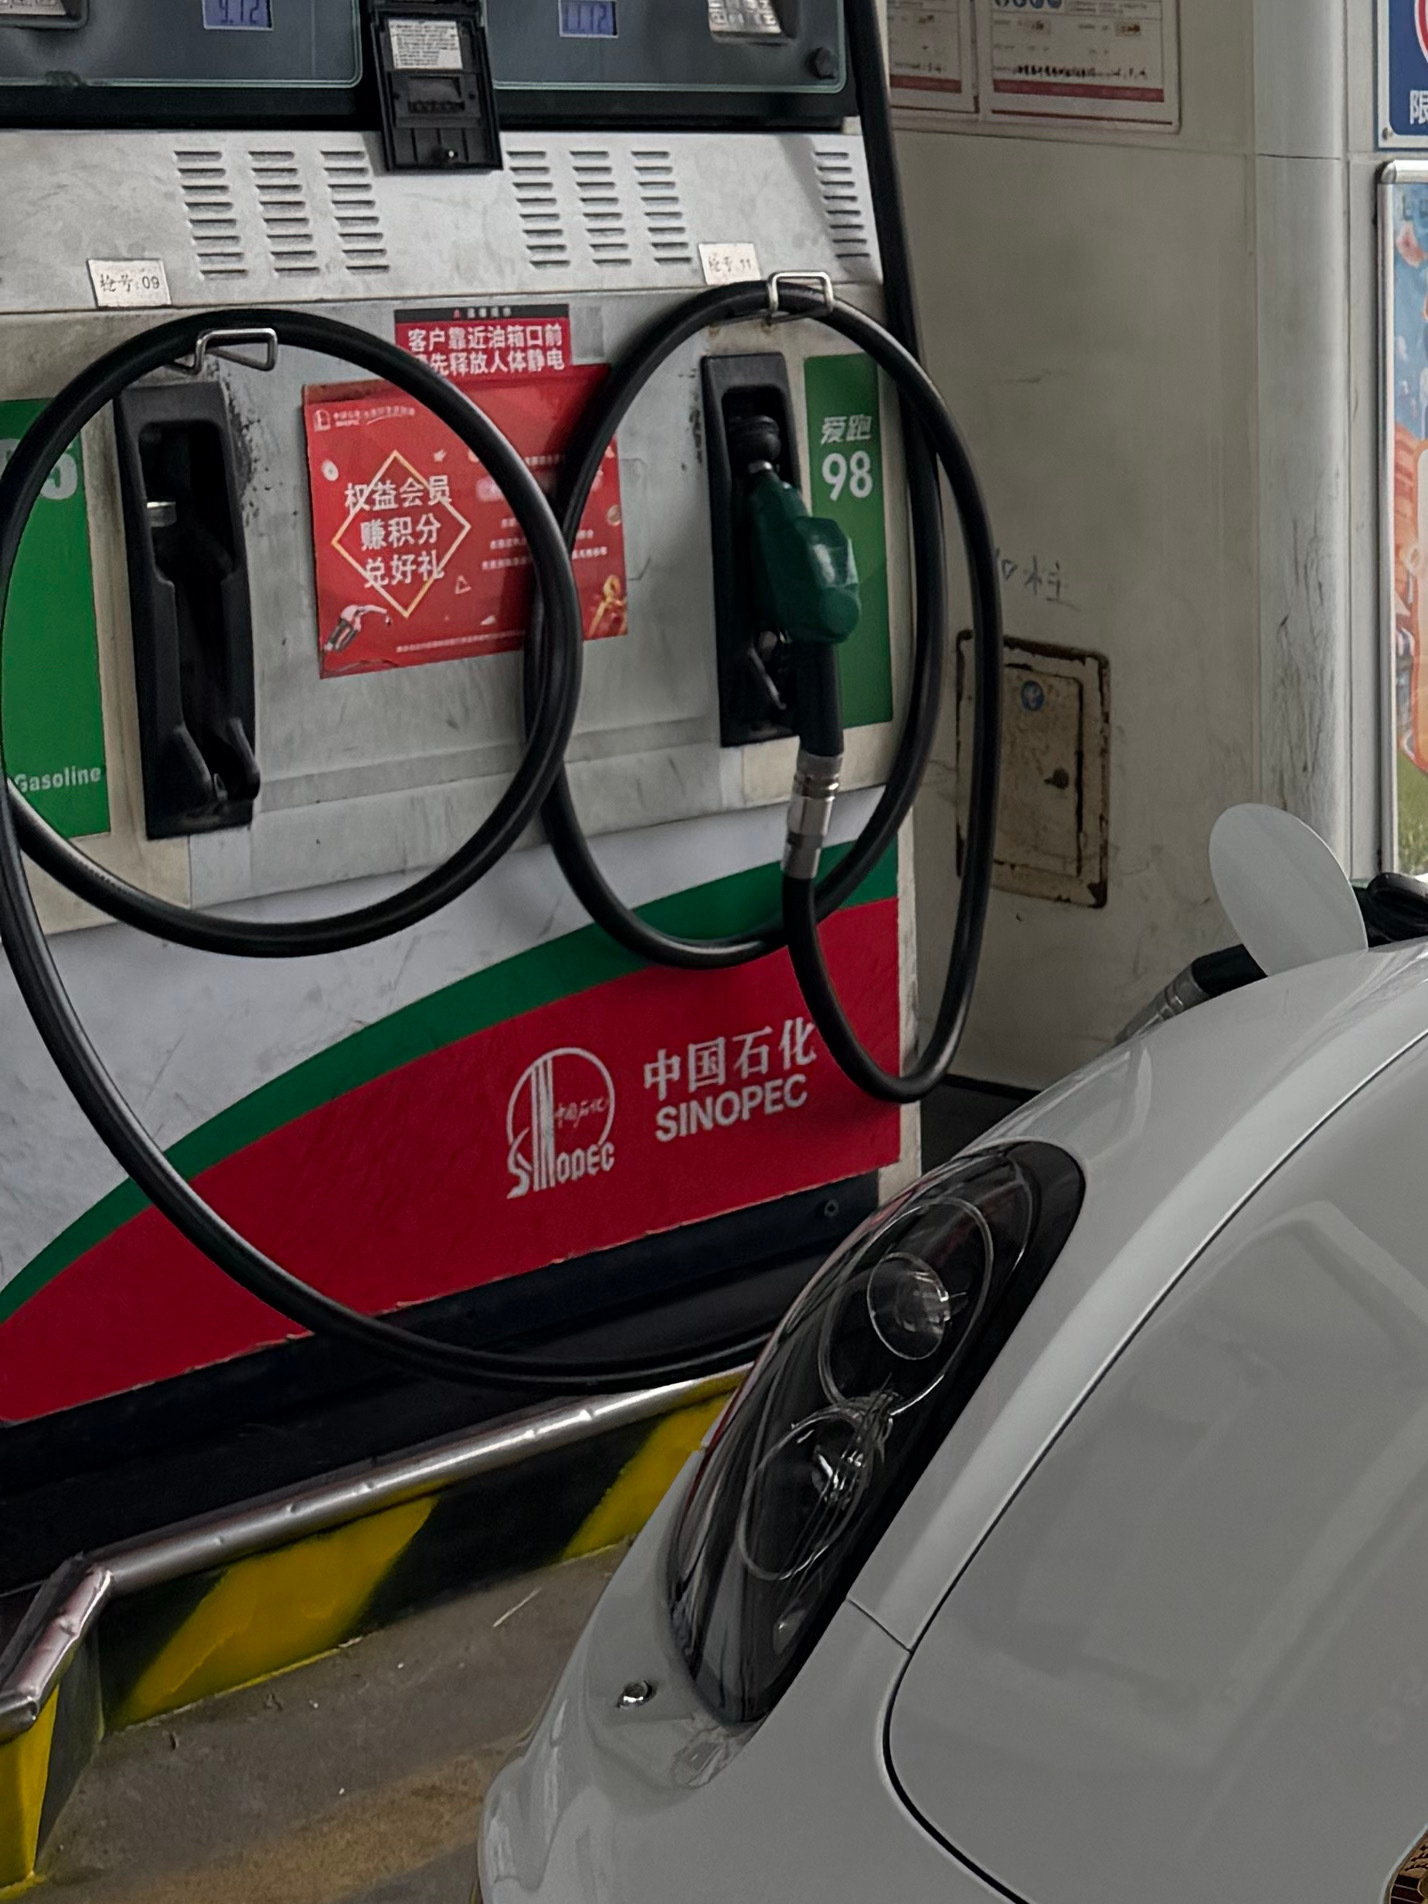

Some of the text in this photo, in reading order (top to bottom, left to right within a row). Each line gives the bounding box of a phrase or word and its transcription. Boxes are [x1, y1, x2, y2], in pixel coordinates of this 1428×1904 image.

[408, 323, 563, 352] 客户靠近油箱口前
[821, 414, 872, 444] 爱跑
[344, 474, 452, 515] 权益会员
[822, 450, 873, 501] 98
[360, 513, 442, 551] 赚积分
[363, 550, 445, 589] 兑好礼
[14, 764, 102, 794] Gasoline
[644, 1015, 817, 1102] 中国石化
[654, 1073, 808, 1143] SINOPEC
